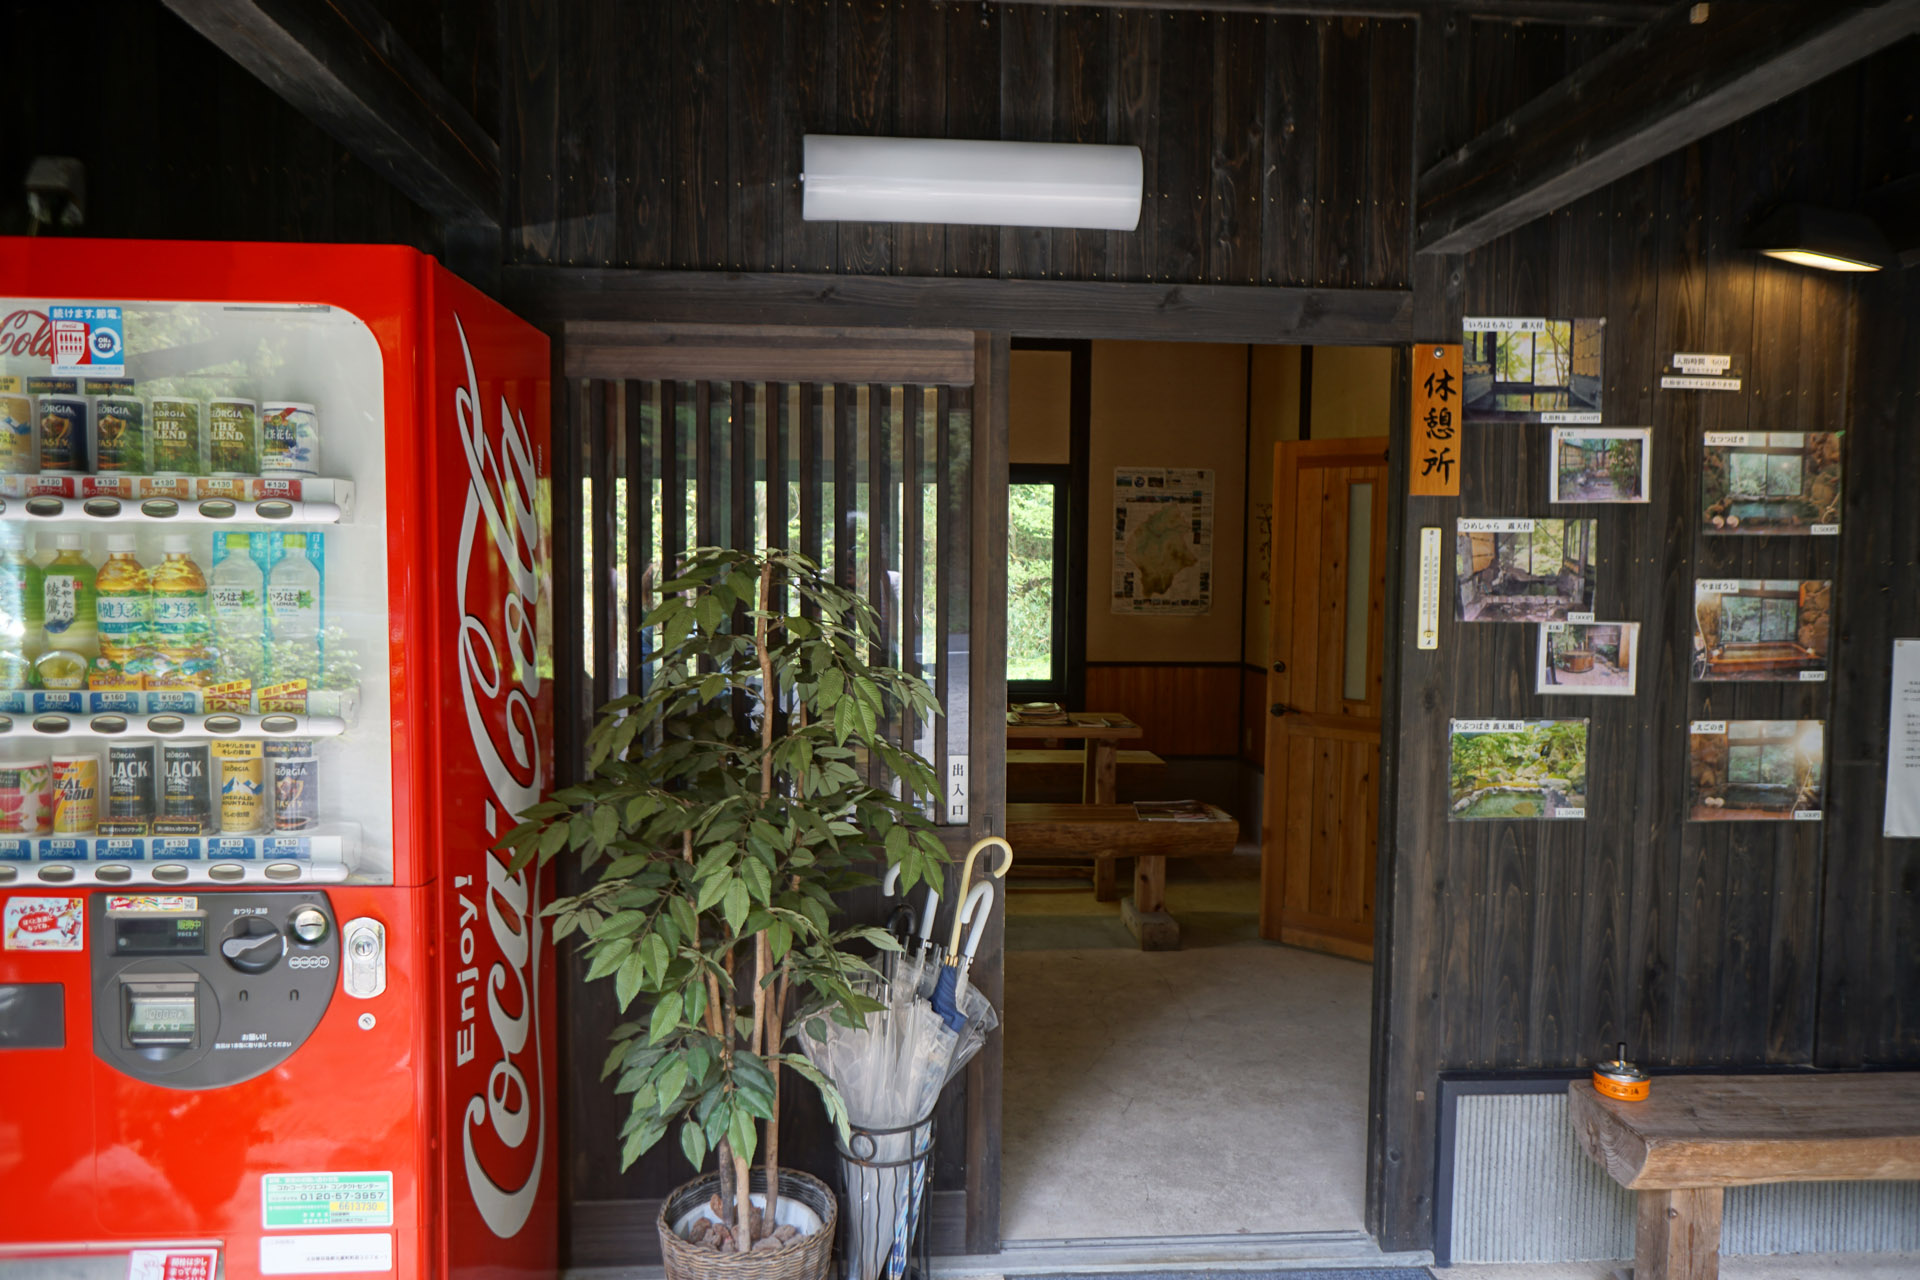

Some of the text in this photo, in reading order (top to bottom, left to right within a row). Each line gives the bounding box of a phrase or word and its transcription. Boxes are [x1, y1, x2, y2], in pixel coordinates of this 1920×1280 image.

[1468, 320, 1514, 330] いろはもみじ
[153, 410, 187, 418] EORGIA
[211, 408, 244, 418] EORGIA
[156, 421, 179, 431] THE
[213, 421, 237, 432] THE
[1421, 368, 1457, 487] 休憩所
[153, 430, 187, 440] LEND
[210, 431, 245, 441] LEND
[1709, 434, 1746, 444] なつつばき
[1462, 521, 1500, 531] ひめしゃら
[1700, 582, 1737, 591] やまぼうし
[46, 581, 61, 616] 綾鷹
[61, 578, 73, 618] あやたか
[155, 601, 199, 619] 健美茶
[1455, 722, 1523, 731] やぶつばき 露天風呂
[1696, 722, 1724, 732] えごのき
[110, 760, 149, 778] LACK
[165, 760, 202, 777] LACK
[64, 788, 95, 801] GOLD
[952, 763, 964, 816] 出入口
[454, 874, 478, 1067] Enjoy!
[338, 1202, 378, 1211] 6613730
